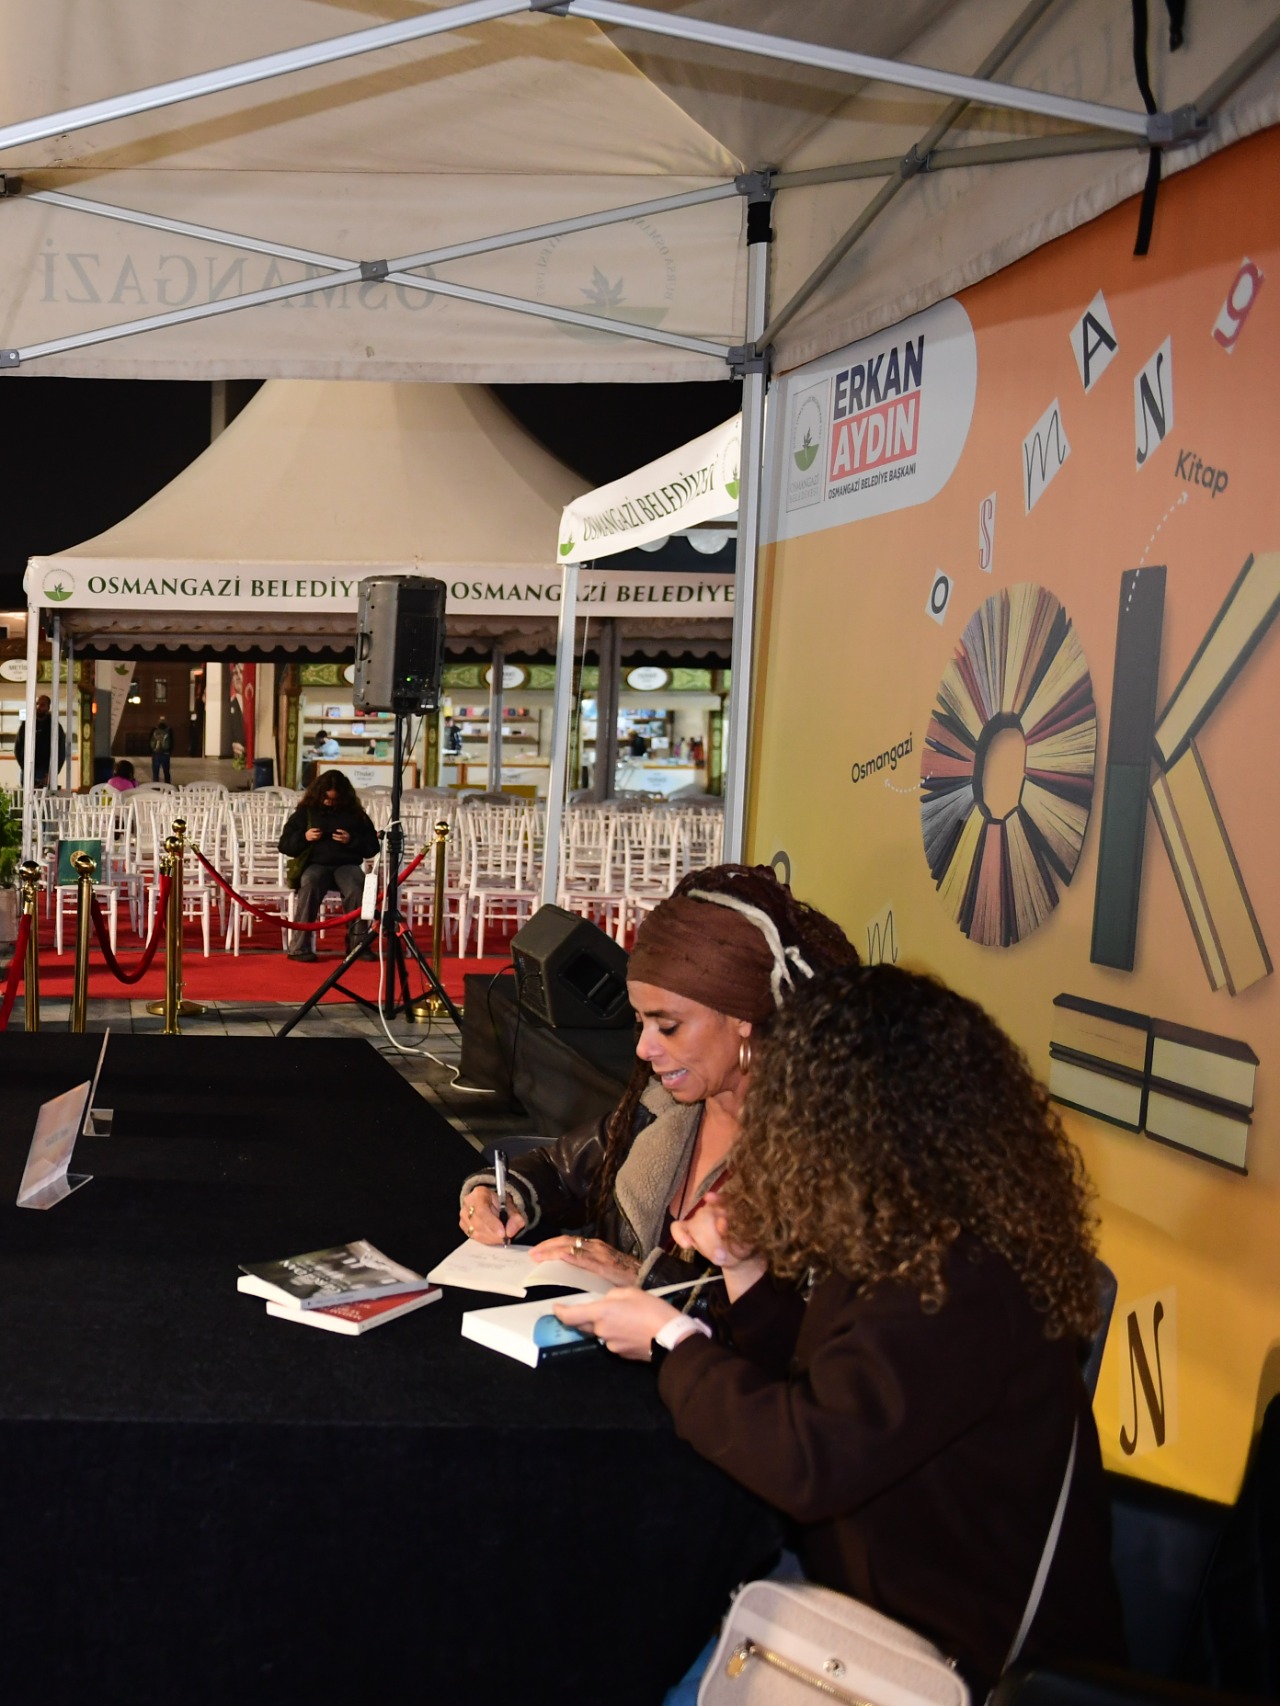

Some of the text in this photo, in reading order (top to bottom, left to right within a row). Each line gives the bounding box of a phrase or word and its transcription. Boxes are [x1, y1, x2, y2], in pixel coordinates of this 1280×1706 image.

[833, 335, 925, 421] ERKAN
[832, 398, 916, 475] AYDIN
[828, 462, 917, 500] OSMANGAZİ BELEDİYE BAŞKANI
[1175, 449, 1229, 498] Kitap
[87, 575, 361, 599] OSMANGAZİ BELEDİY
[450, 580, 734, 603] OSMANGZİ BELEDİYE
[851, 731, 913, 783] Osmangazi
